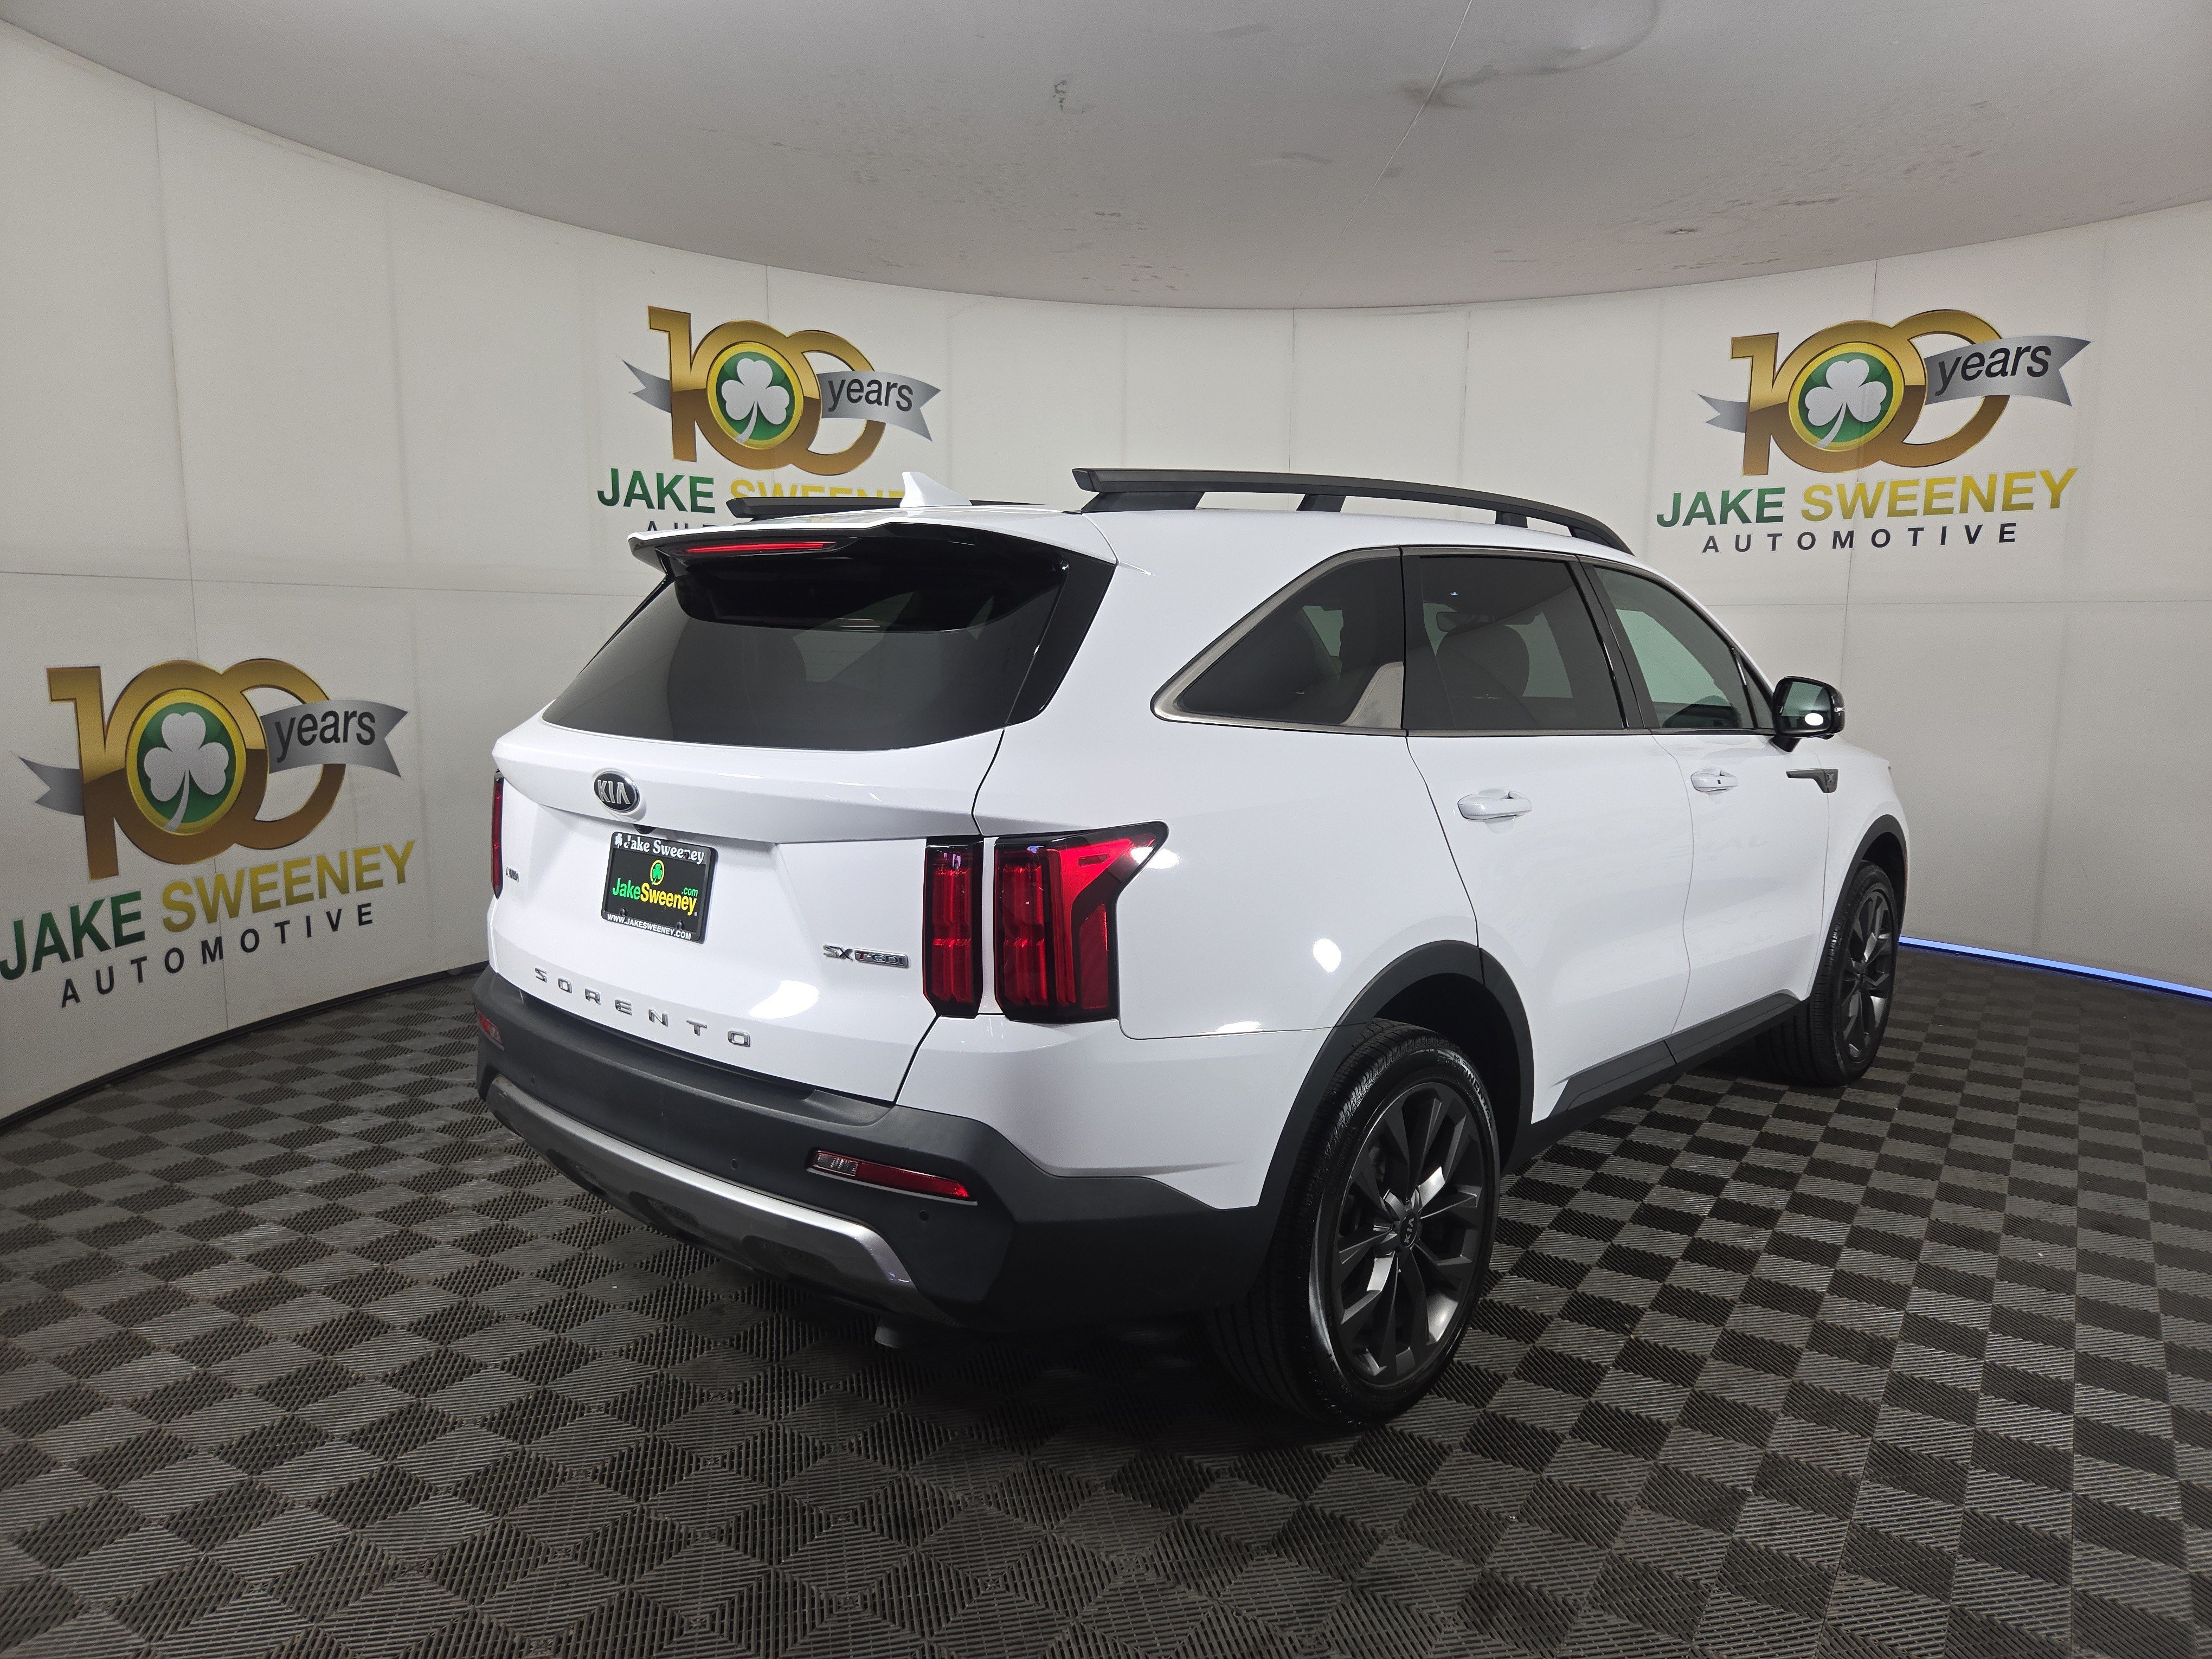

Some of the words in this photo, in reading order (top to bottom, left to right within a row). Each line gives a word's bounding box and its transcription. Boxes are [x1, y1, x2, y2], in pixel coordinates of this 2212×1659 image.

[647, 306, 886, 475] 100
[828, 379, 914, 412] years
[1731, 309, 2011, 476] 100
[1935, 345, 2052, 396] years
[597, 468, 716, 513] JAKE
[1656, 487, 1786, 528] JAKE
[1801, 468, 2079, 522] SWEENEY
[1702, 523, 2017, 553] AUTOMOTIVE
[47, 658, 346, 882] 100
[274, 709, 377, 763] years
[597, 779, 631, 805] KIA
[624, 835, 650, 852] Jake
[653, 840, 705, 864] Sweeney
[0, 890, 146, 981] JAKE
[162, 840, 416, 933] SWEENEY
[681, 887, 699, 897] .com
[607, 913, 692, 941] WWW.JAKESWEENEY.COM
[61, 902, 374, 1008] AUTOMOTIVE
[823, 943, 854, 962] SX
[535, 967, 751, 1048] SORENTO
[1403, 1218, 1415, 1244] KIA
